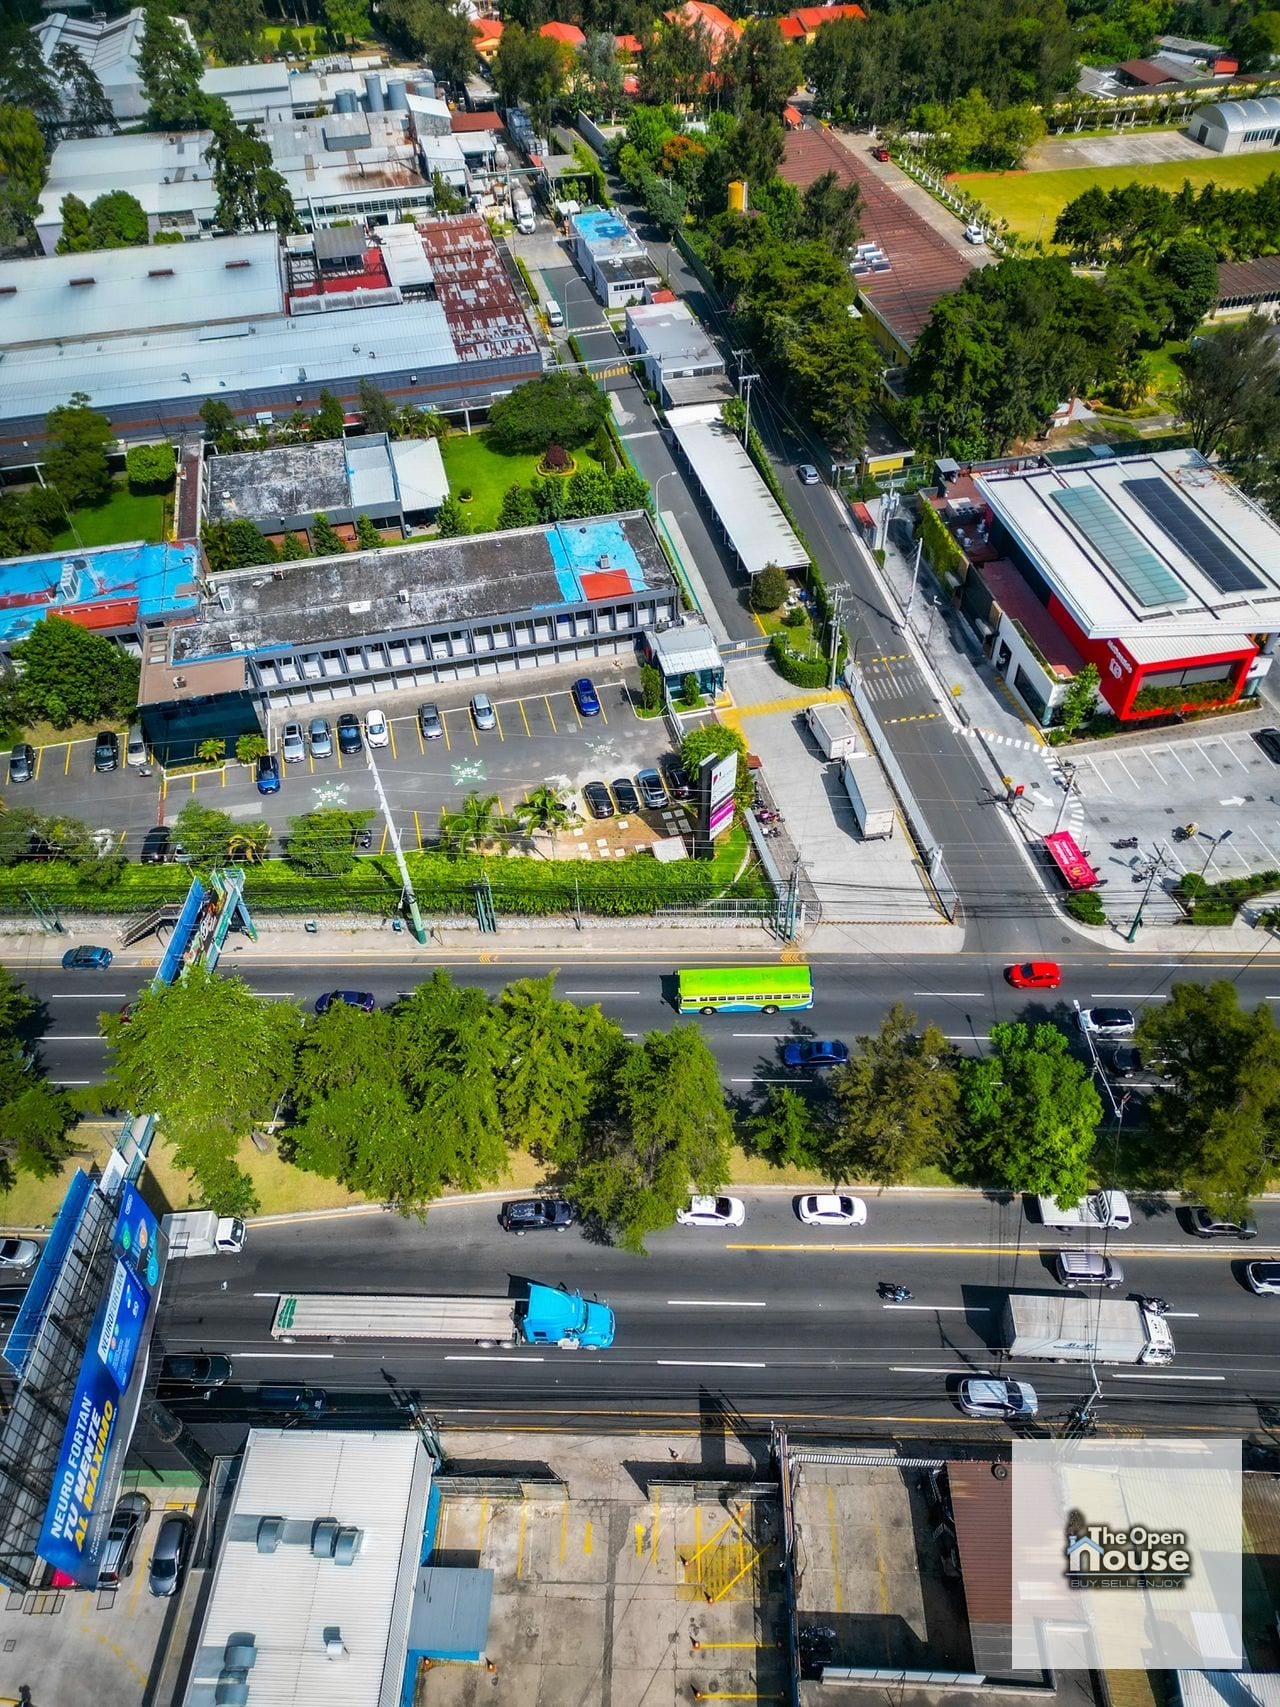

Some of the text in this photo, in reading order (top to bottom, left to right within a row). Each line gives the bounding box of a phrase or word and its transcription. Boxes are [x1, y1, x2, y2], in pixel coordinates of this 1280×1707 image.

[50, 1396, 92, 1539] NEURO FORTAN
[63, 1407, 101, 1542] TU MENTE
[75, 1515, 88, 1552] AL
